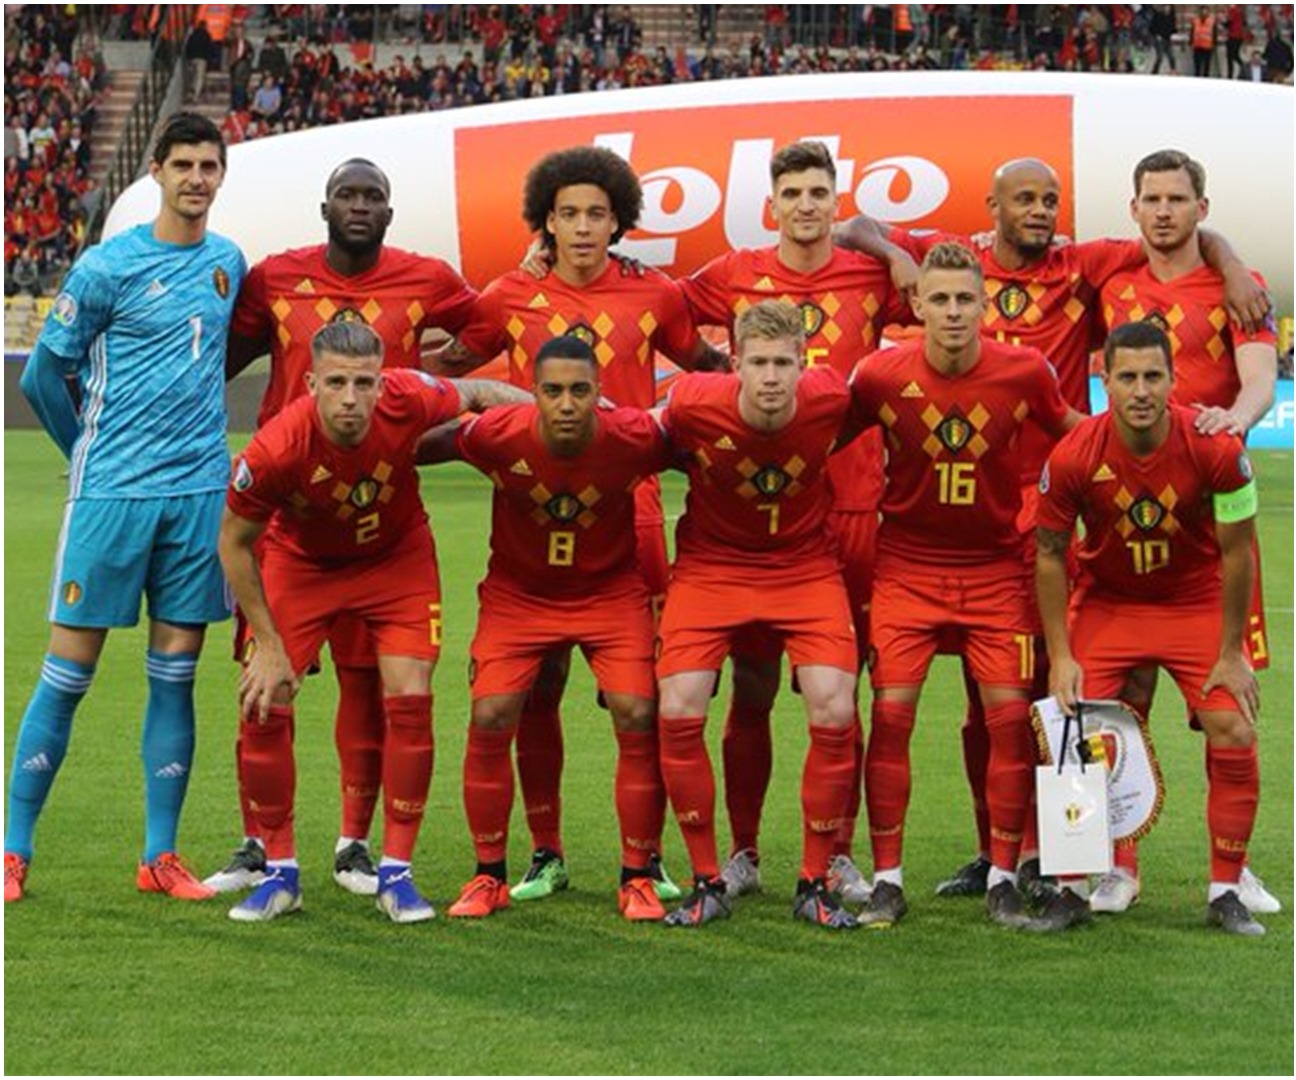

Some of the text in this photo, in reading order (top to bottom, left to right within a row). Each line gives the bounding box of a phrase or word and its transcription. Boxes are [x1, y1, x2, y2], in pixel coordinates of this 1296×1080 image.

[188, 315, 203, 360] 1
[934, 462, 975, 504] 16
[356, 512, 380, 545] 2
[757, 503, 779, 534] 7
[548, 531, 575, 566] 8
[1126, 539, 1169, 574] 10
